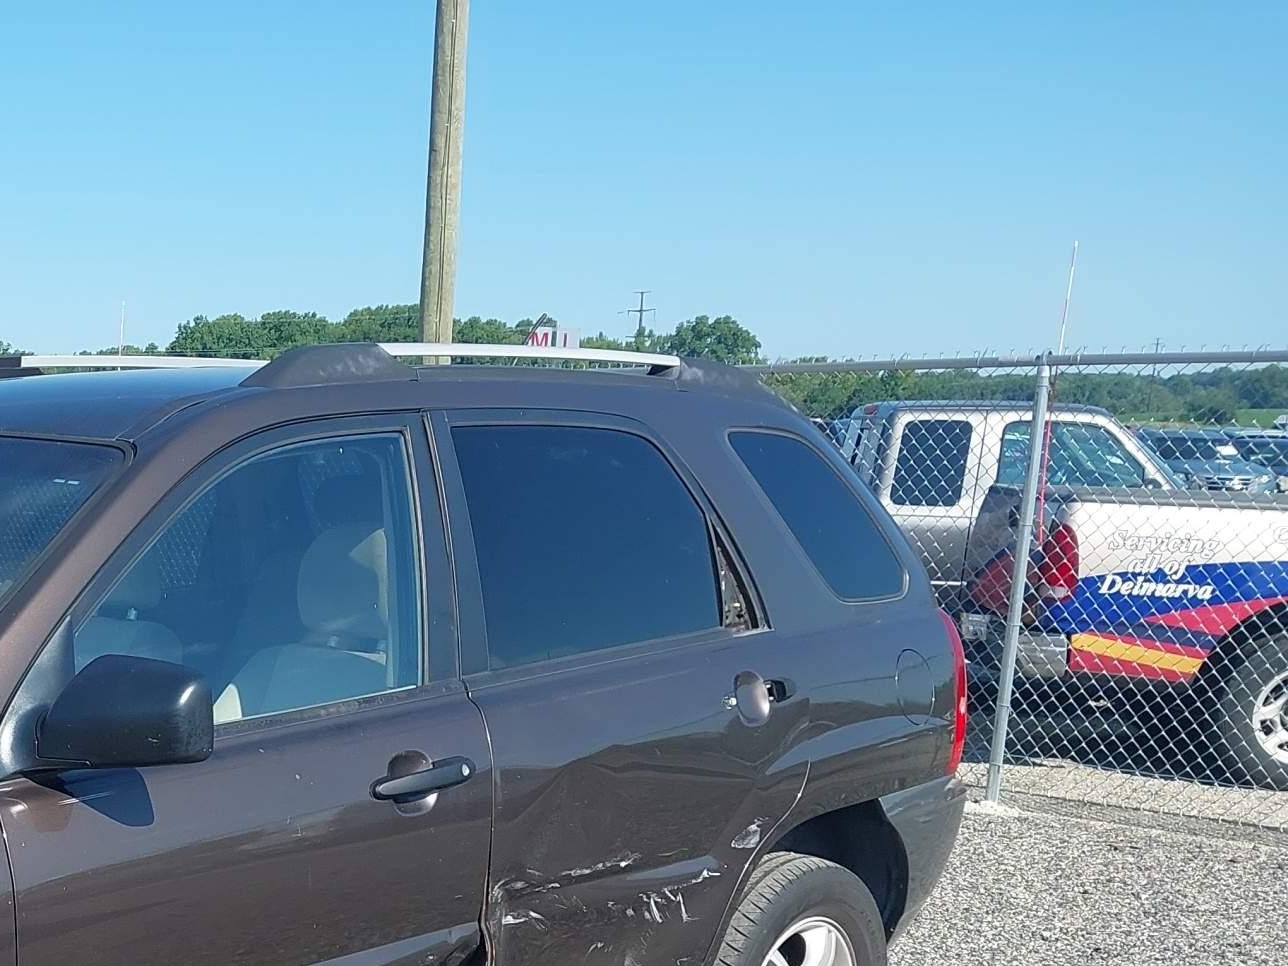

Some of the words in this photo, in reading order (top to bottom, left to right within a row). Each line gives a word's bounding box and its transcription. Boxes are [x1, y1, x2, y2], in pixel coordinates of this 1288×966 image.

[1108, 529, 1222, 559] Servicing
[1127, 552, 1162, 573] all
[1164, 552, 1196, 579] of
[1098, 574, 1215, 600] Delmarva
